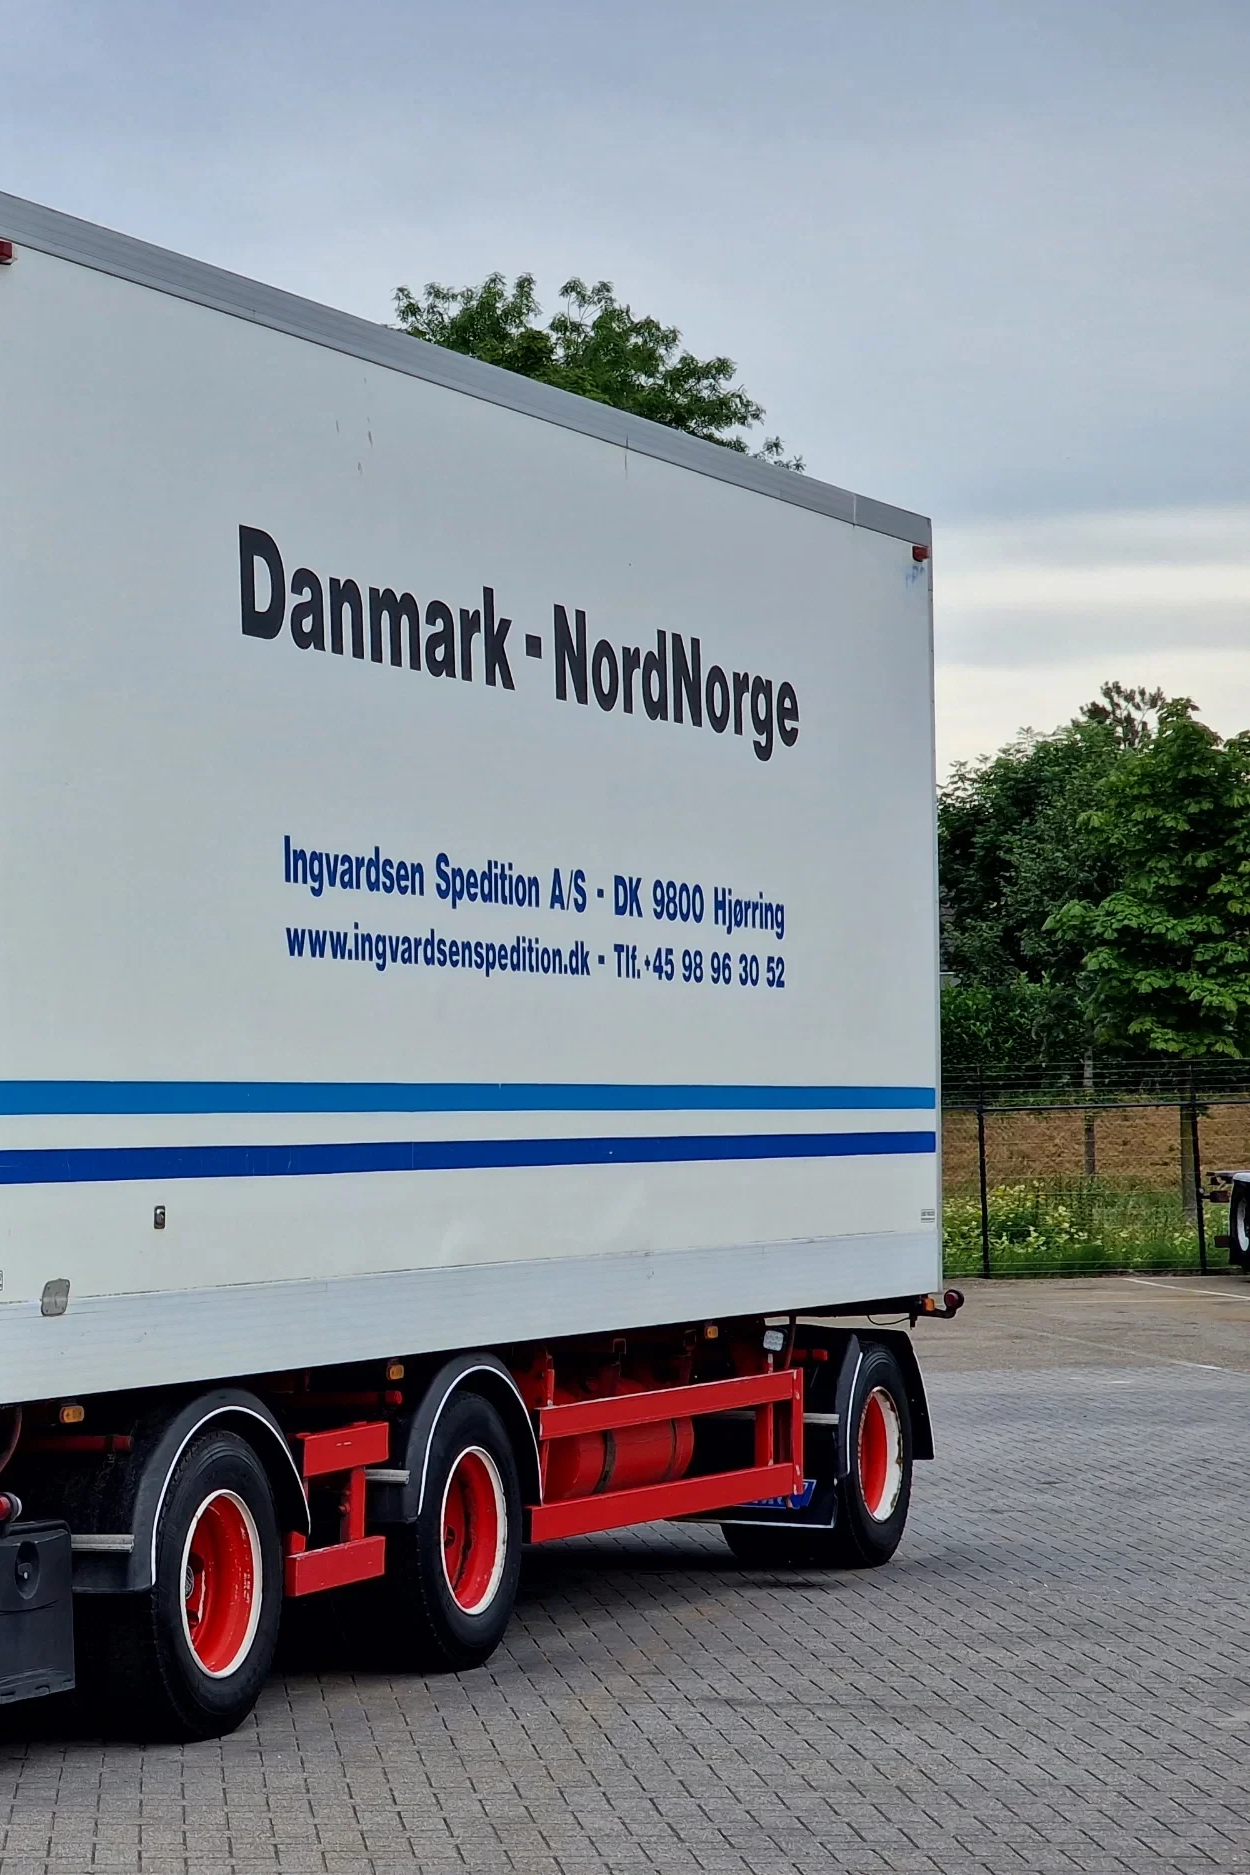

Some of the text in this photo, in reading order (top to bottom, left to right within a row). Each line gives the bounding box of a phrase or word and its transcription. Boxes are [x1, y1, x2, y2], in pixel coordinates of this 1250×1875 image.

[238, 523, 516, 691] Danmark
[553, 602, 800, 762] NordNorge
[283, 834, 425, 898] Ingvardsen
[435, 852, 540, 910] Spedition
[549, 867, 587, 913] A/S
[613, 874, 643, 918] DK
[652, 878, 705, 924] 9800
[713, 886, 785, 940] Hjørring
[285, 921, 590, 978] www.ingvardsenspedition.dk
[681, 949, 704, 984] 98
[710, 951, 732, 985] 96
[738, 953, 760, 987] 30
[766, 955, 785, 988] 52
